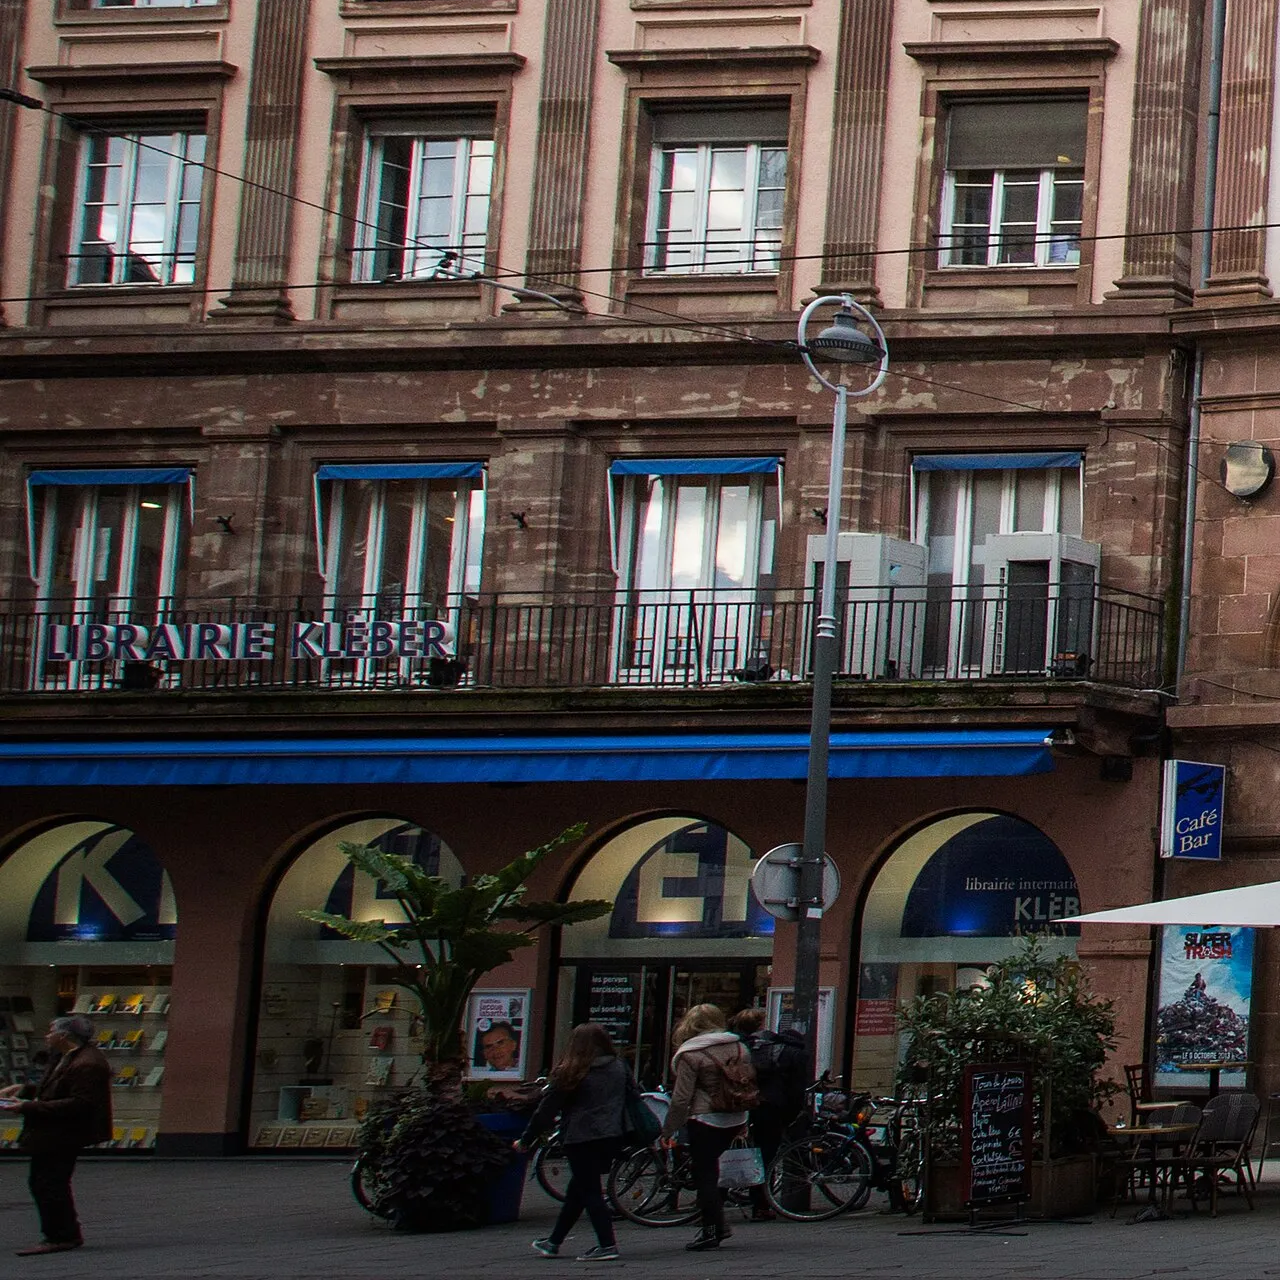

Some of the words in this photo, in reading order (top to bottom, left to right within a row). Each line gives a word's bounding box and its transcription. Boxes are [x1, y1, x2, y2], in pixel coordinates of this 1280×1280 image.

[48, 623, 275, 660] LIBRAIRIE
[1176, 808, 1218, 834] Café
[1179, 832, 1213, 854] Bar
[965, 877, 1015, 891] librairie
[1184, 932, 1232, 947] SUPER
[591, 975, 602, 983] les
[602, 976, 629, 985] pervers
[591, 986, 634, 995] narcissiques
